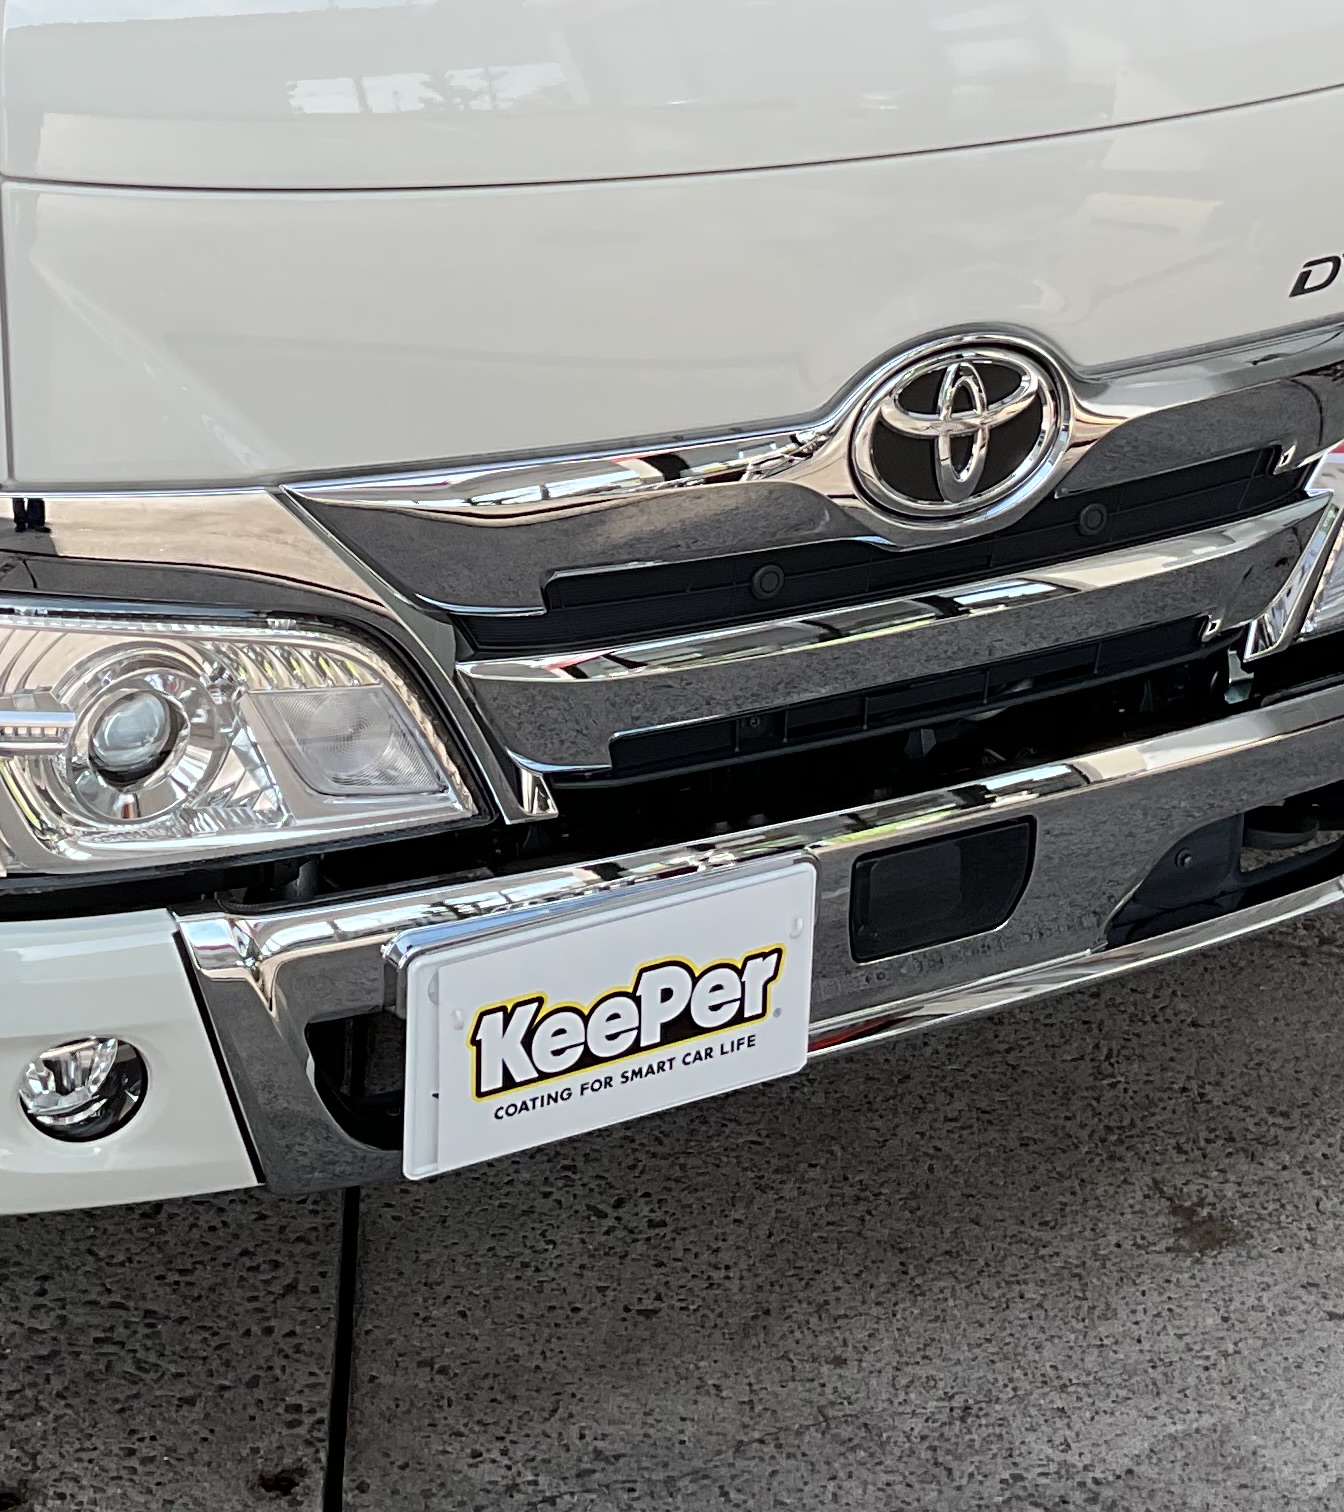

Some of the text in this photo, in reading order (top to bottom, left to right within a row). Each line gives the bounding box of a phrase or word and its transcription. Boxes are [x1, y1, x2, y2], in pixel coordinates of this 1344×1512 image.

[470, 946, 784, 1099] KeePer
[493, 1034, 757, 1120] COATING FOR SMART CAR LIFE
